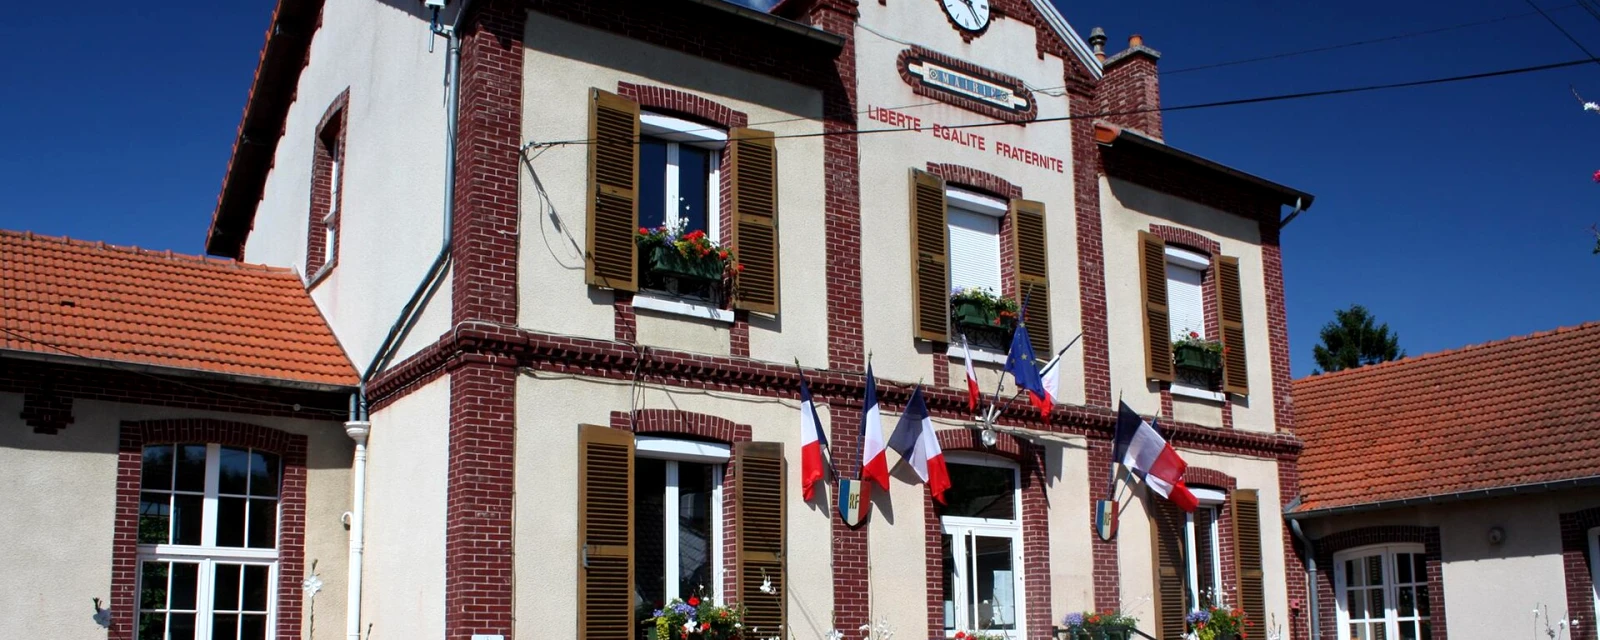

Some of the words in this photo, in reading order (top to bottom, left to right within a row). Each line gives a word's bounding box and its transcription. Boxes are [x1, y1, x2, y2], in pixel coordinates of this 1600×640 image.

[942, 72, 997, 99] MAIRIE
[868, 105, 922, 132] LIBERTE
[933, 123, 985, 151] EGALITE
[996, 142, 1064, 173] FRATERNITE
[849, 494, 860, 509] RF
[1103, 512, 1112, 526] RF
